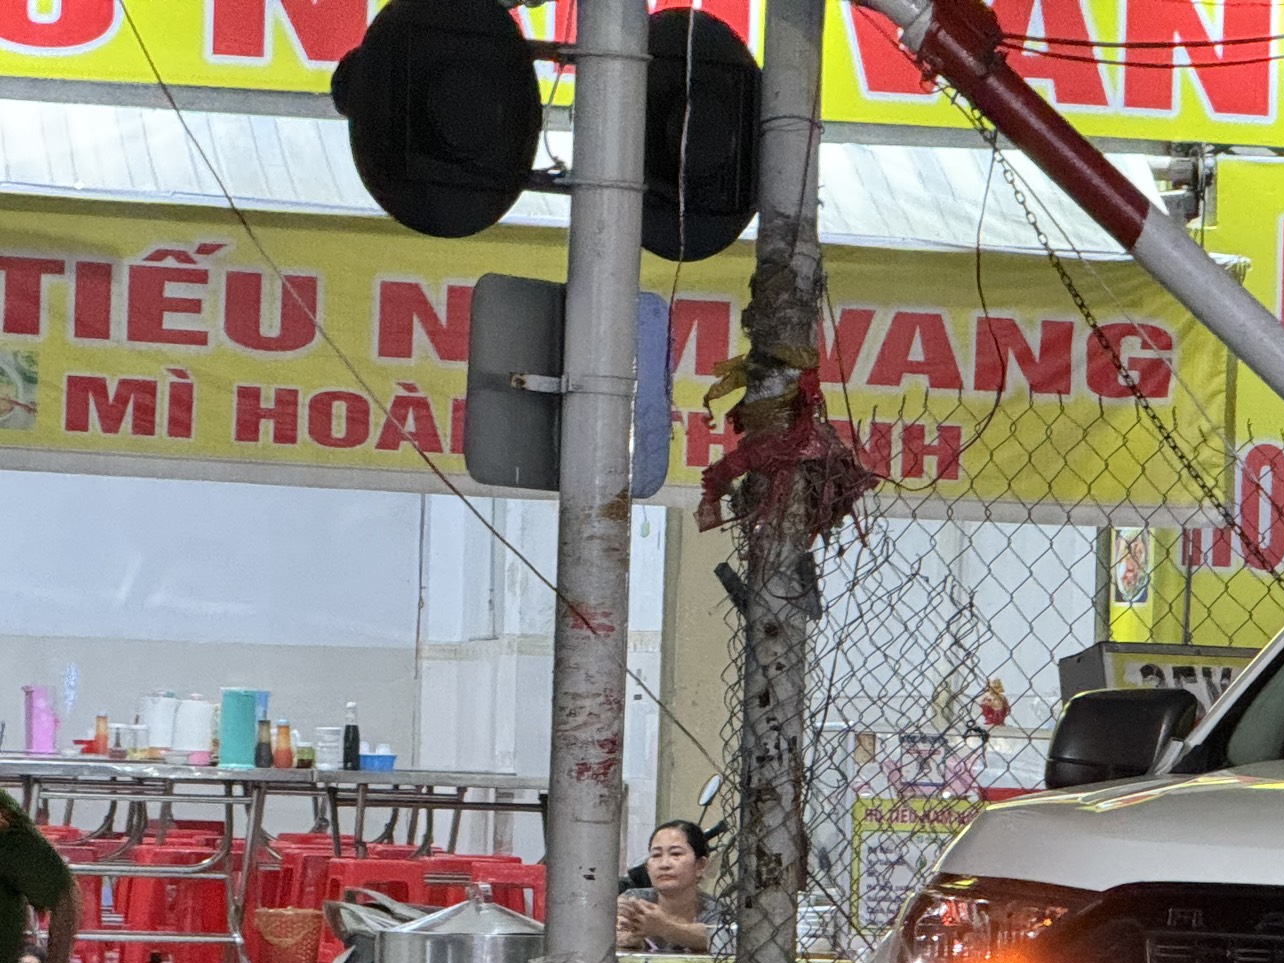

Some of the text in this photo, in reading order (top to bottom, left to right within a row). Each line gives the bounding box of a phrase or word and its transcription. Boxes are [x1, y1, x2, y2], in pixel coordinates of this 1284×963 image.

[0, 244, 1173, 398] TIẾU NM VANG
[64, 368, 192, 439] MÌ
[235, 384, 465, 453] HOÀ
